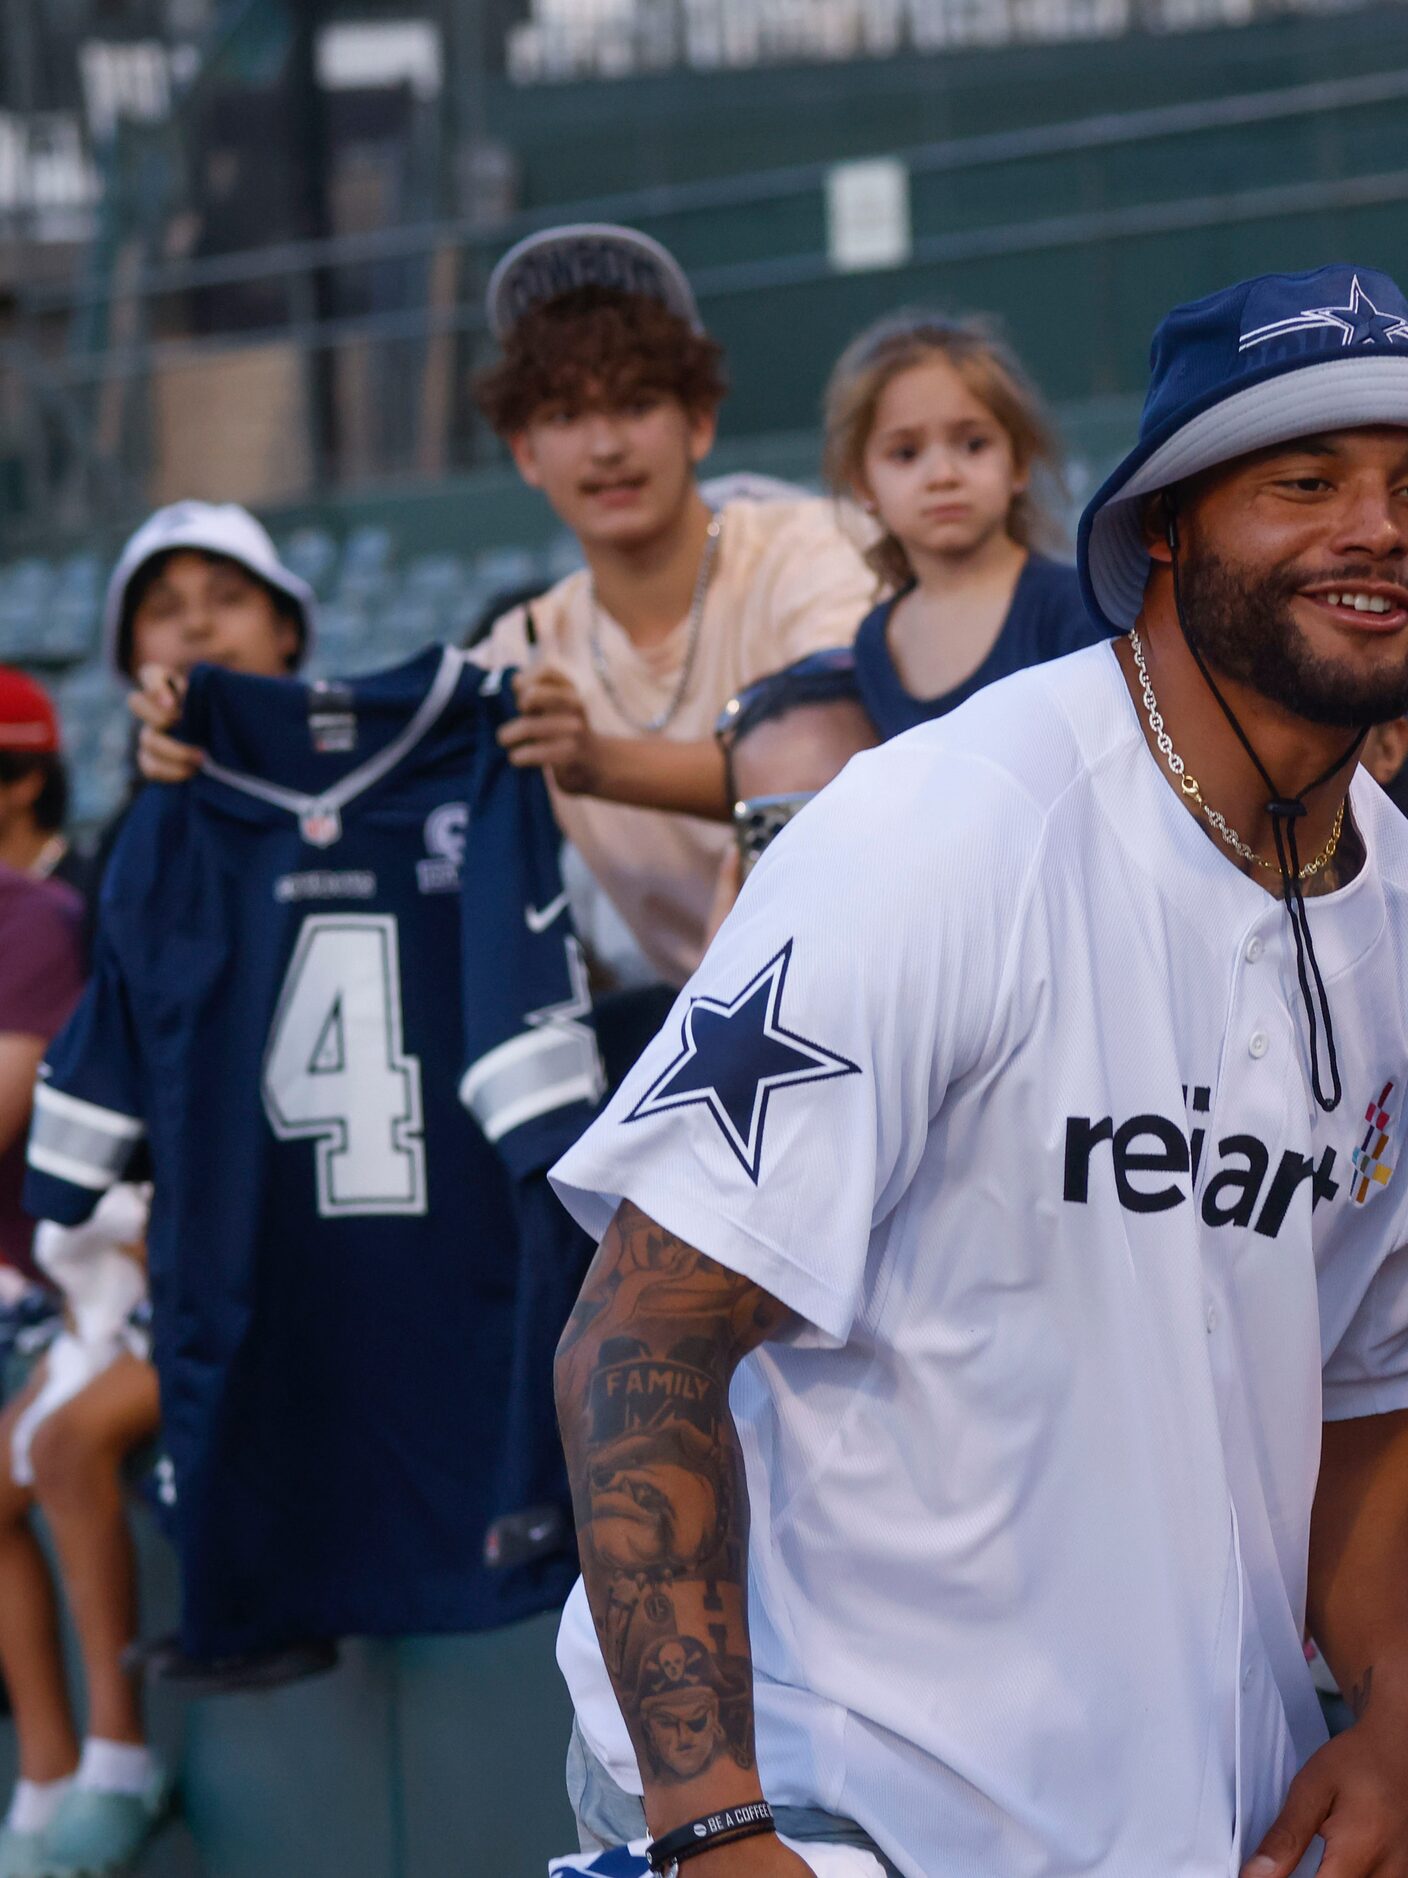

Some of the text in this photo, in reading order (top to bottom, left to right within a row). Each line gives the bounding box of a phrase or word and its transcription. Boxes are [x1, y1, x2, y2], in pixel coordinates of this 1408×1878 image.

[260, 912, 428, 1217] 4
[606, 1369, 711, 1401] FAMILY
[707, 1814, 725, 1833] BE
[725, 1811, 735, 1827] A
[734, 1802, 770, 1824] COFFEE
